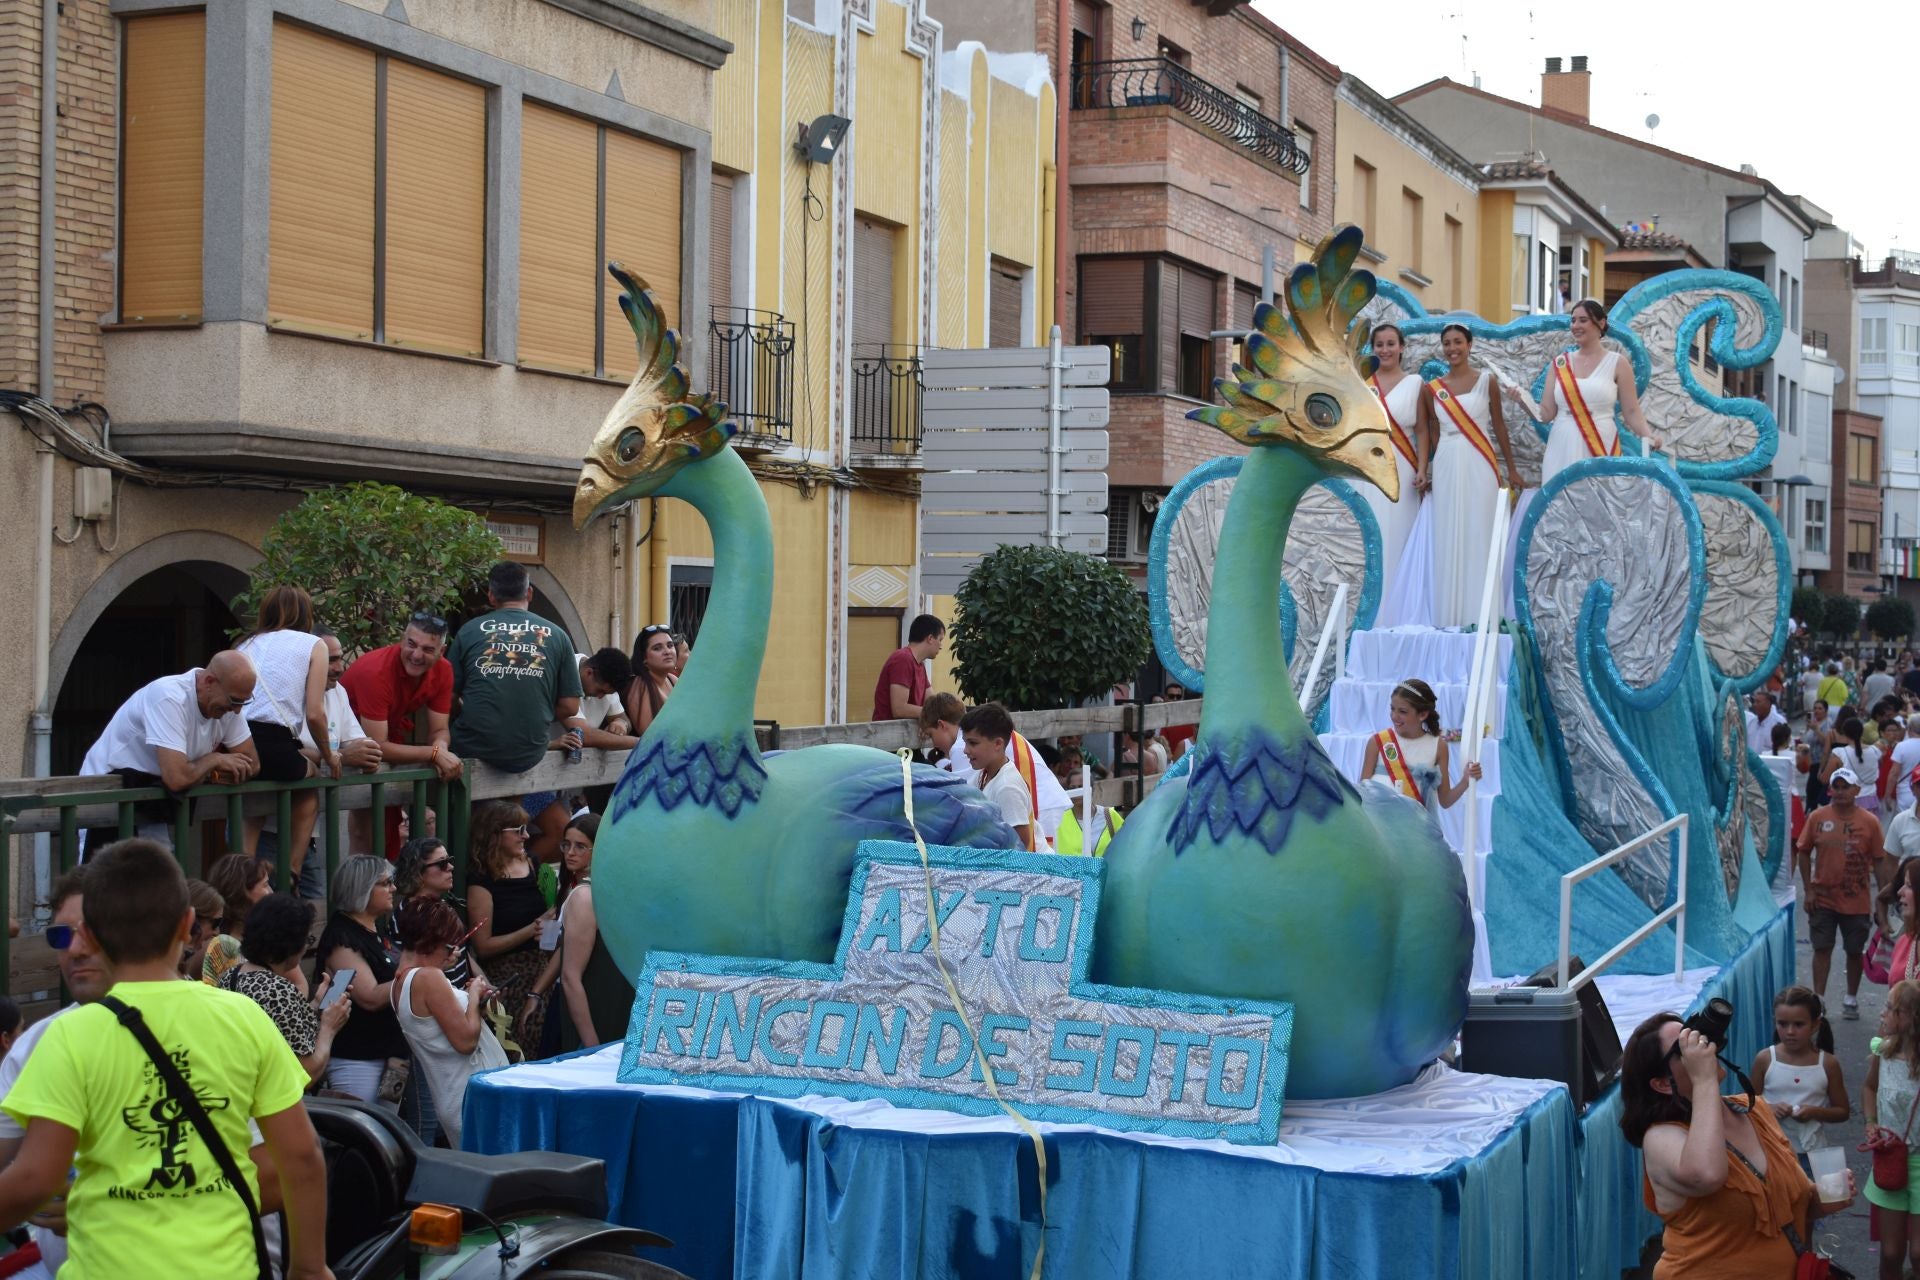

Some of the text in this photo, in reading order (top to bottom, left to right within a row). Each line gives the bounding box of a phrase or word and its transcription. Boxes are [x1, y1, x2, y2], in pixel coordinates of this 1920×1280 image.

[480, 619, 552, 637] Garden
[491, 642, 538, 654] UNDER
[475, 656, 545, 680] Construction
[857, 887, 1075, 963] AYTO
[650, 988, 1264, 1110] RINCON DE SOTO
